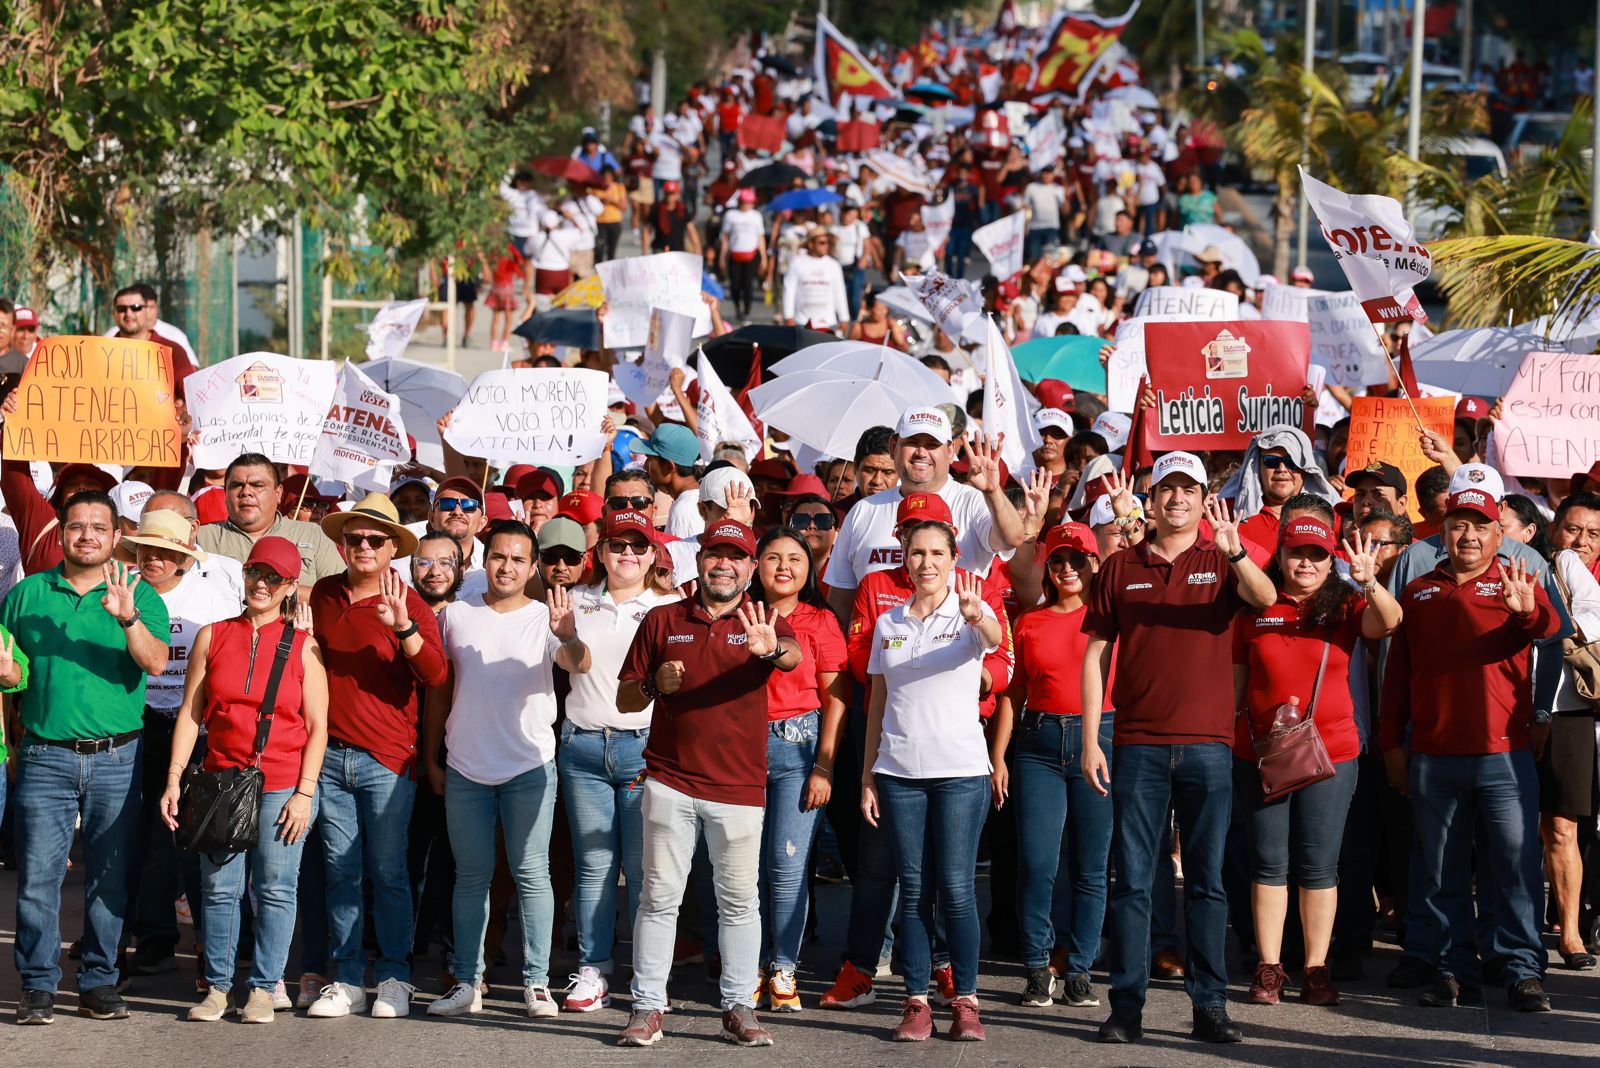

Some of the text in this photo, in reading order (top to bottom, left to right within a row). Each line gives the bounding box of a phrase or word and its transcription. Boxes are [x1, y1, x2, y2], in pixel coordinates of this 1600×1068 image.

[1135, 289, 1226, 318] ATENEA
[34, 340, 169, 382] AQUÍ Y ALLÁ
[1518, 357, 1547, 393] Mi
[521, 379, 588, 403] MORENA
[26, 383, 139, 425] ATENEA
[360, 393, 390, 409] VOTA
[1375, 399, 1384, 418] A
[550, 403, 586, 430] POR
[910, 412, 942, 424] ATENEA
[1158, 385, 1304, 435] Leticia Suriano
[198, 416, 227, 428] Las
[297, 411, 309, 426] de
[326, 404, 400, 439] ATENE
[274, 426, 288, 440] te
[1373, 421, 1384, 437] T
[6, 426, 178, 462] VA A ARRASAR
[237, 440, 318, 460] ATENE
[338, 432, 387, 452] PRESIDENTA
[1370, 439, 1377, 455] E
[333, 449, 366, 464] morena
[1158, 456, 1194, 467] ATENEA
[1458, 491, 1486, 501] GINO
[909, 500, 925, 510] PT
[615, 512, 647, 525] morena
[714, 527, 744, 538] ALDANA
[1295, 524, 1327, 537] morena
[1188, 572, 1217, 580] ATENEA
